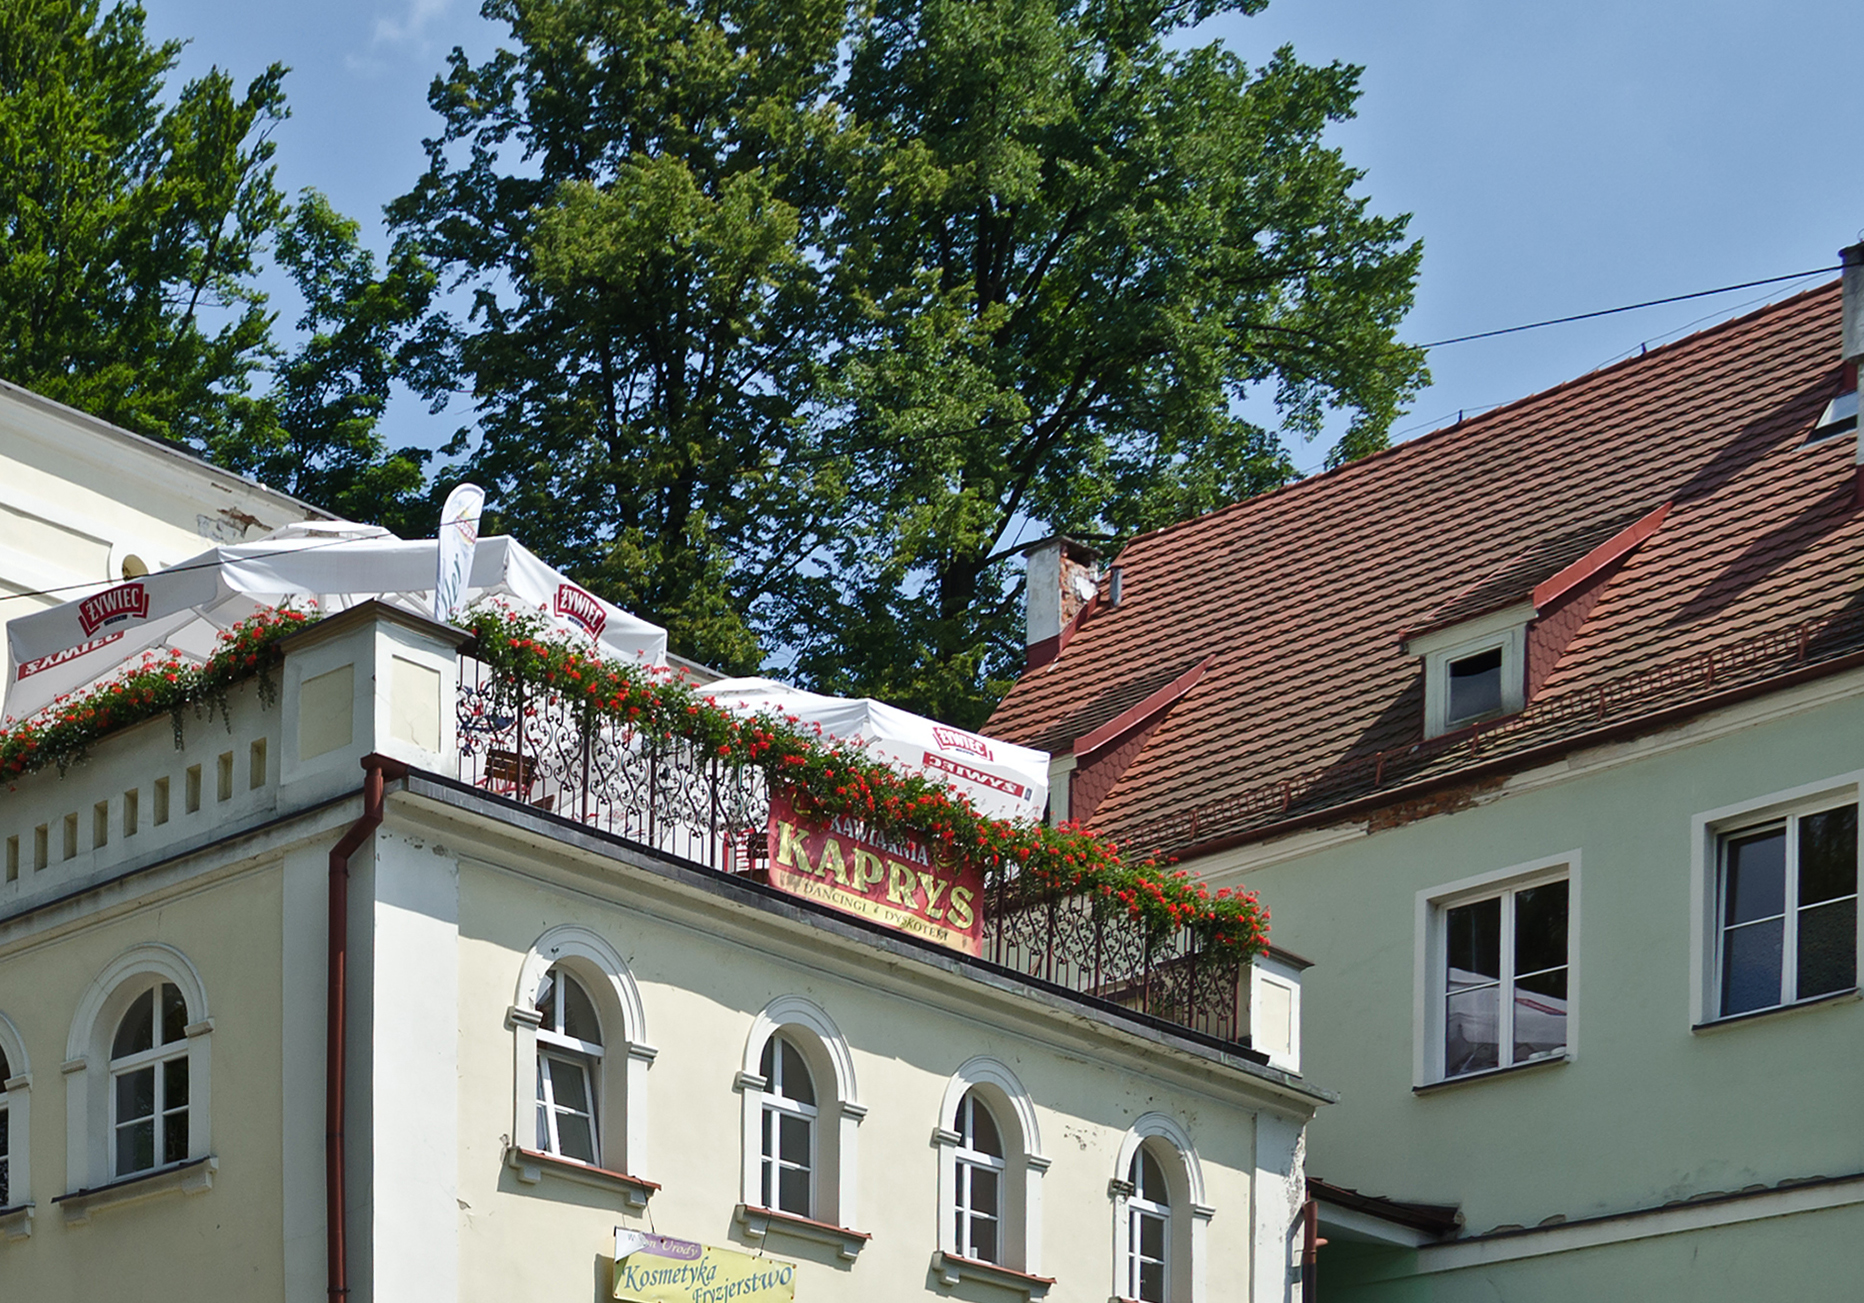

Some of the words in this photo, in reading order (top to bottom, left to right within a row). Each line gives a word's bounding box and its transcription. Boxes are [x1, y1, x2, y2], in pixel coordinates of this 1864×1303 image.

[85, 588, 140, 622] ŻYWIEC
[560, 585, 604, 628] ŻYWIEC
[776, 820, 975, 930] KAPRYS
[803, 882, 867, 913] DANCINGI
[661, 1239, 699, 1258] Urody
[623, 1256, 718, 1292] Kosmetyka
